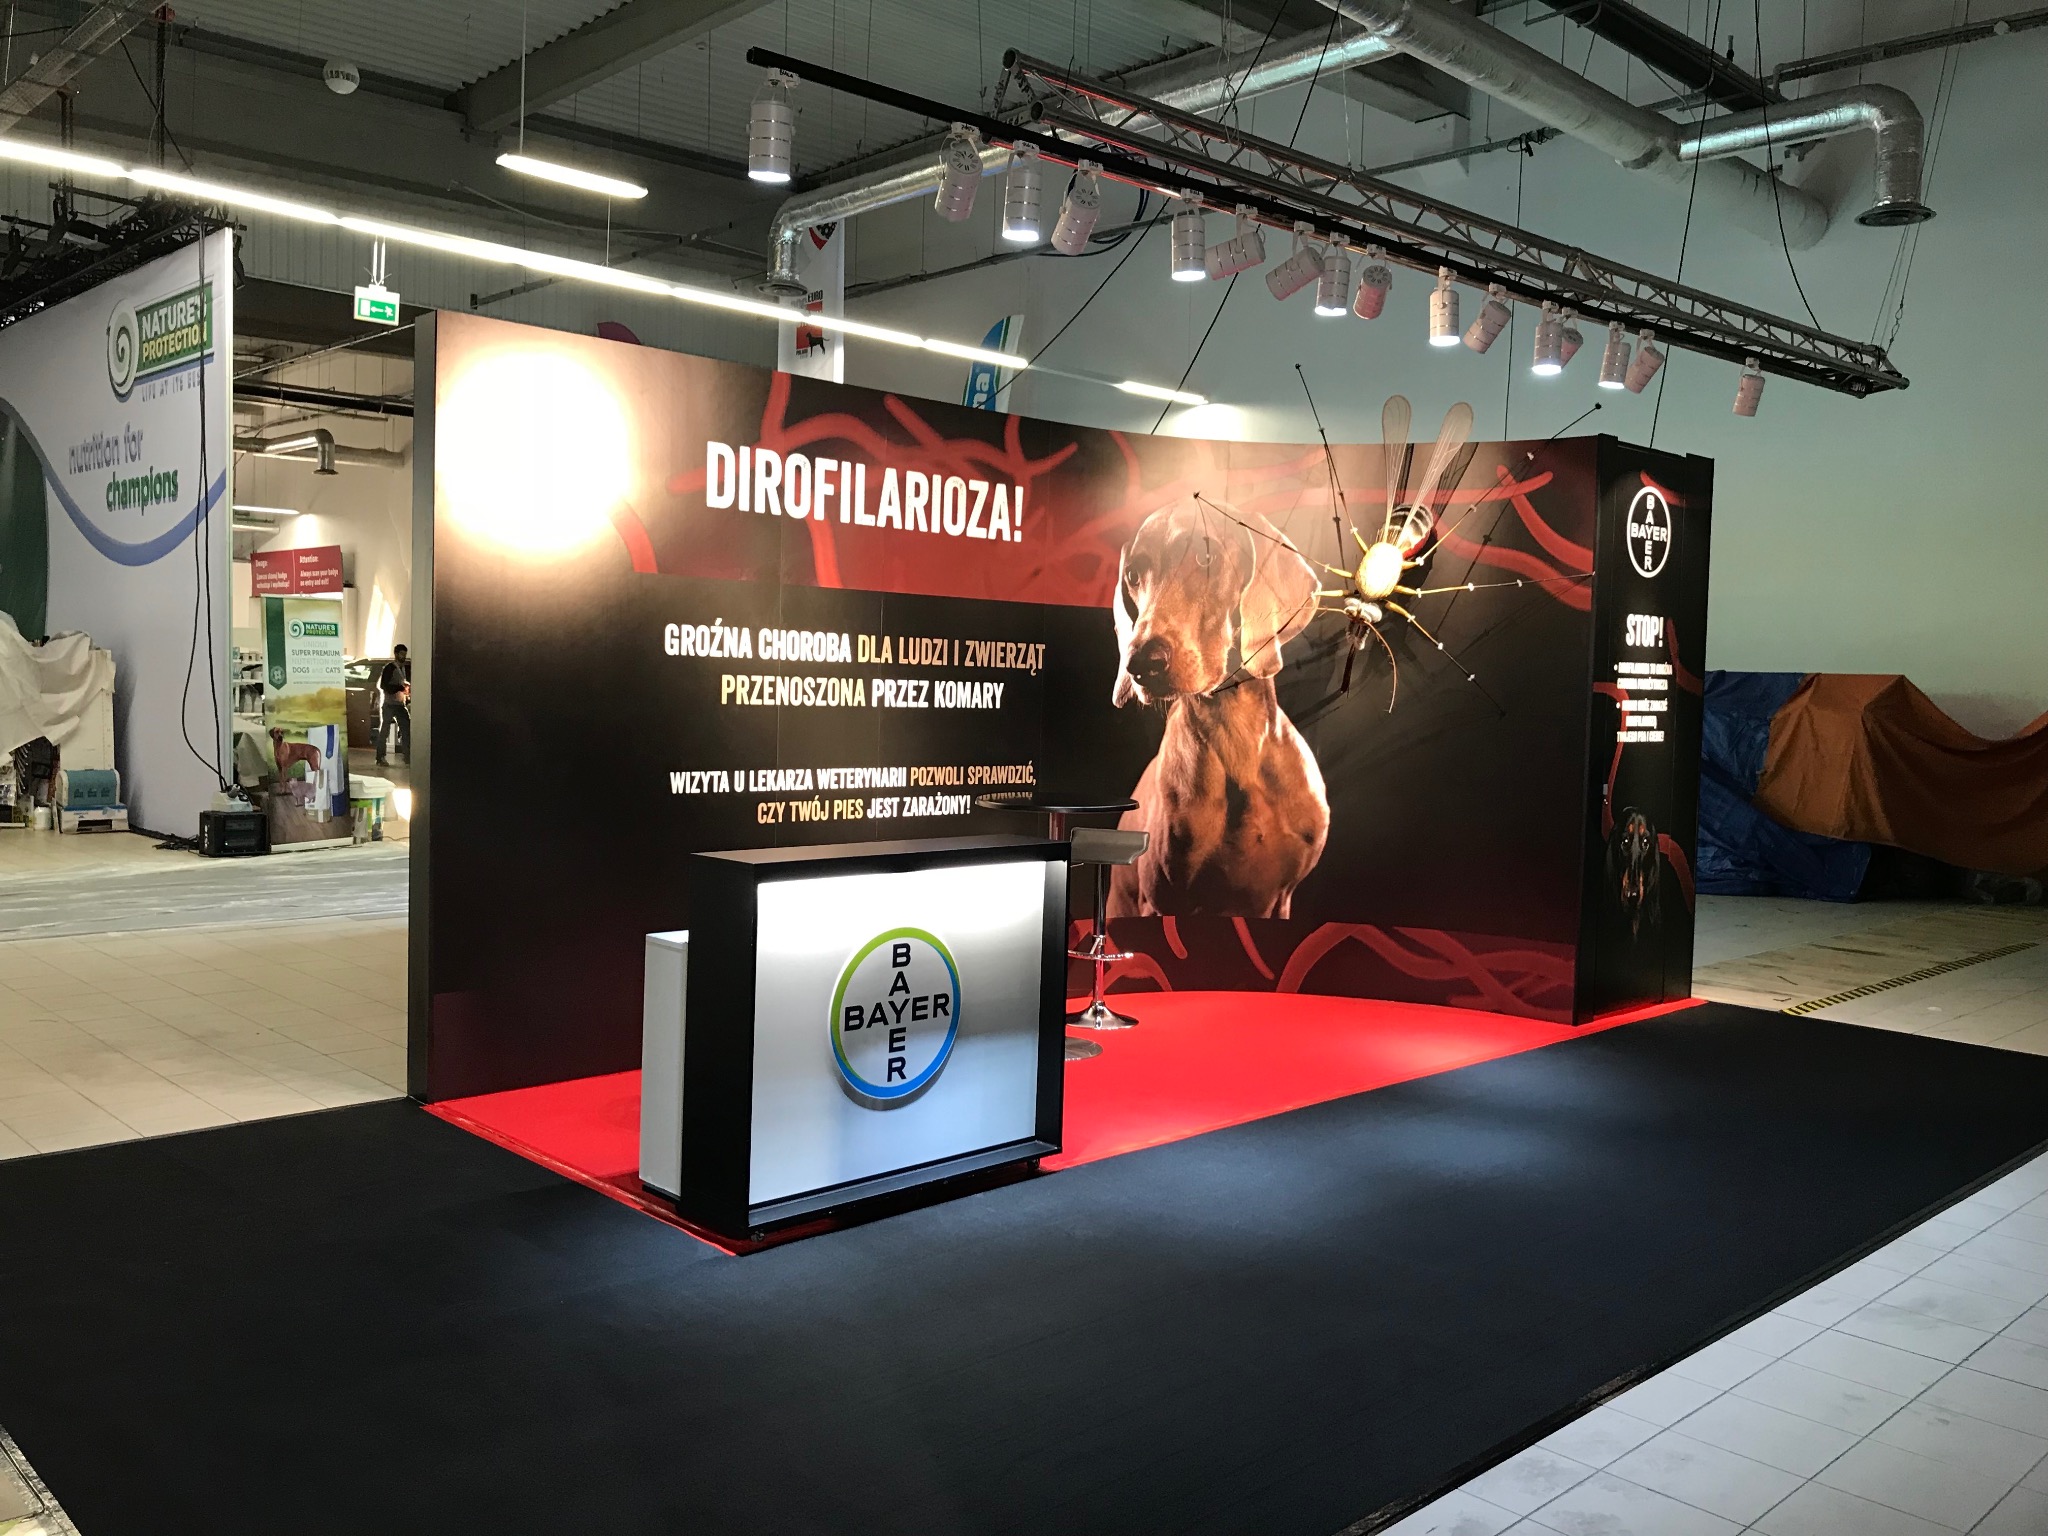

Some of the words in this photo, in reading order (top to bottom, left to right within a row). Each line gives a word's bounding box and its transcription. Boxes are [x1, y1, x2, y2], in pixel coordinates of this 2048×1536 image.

[69, 431, 120, 475] nutrition
[124, 421, 143, 463] for
[106, 465, 178, 516] champions
[706, 440, 1024, 543] DIROFILARIOZA!
[1631, 522, 1667, 542] BAYER
[1643, 494, 1655, 571] BAYER
[305, 623, 336, 631] NATURE'S
[1625, 613, 1664, 648] STOP!
[312, 649, 341, 657] PREMIUM
[664, 617, 753, 659] GROŹNA
[758, 628, 852, 663] CHOROBA
[857, 634, 893, 664] DLA
[898, 636, 948, 666] LUDZI
[954, 639, 959, 666] I
[964, 640, 1046, 676] ZWIERZĄT
[292, 666, 310, 674] DOGS
[721, 674, 866, 707] PRZENOSZONA
[871, 678, 930, 708] PRZEZ
[934, 680, 1005, 709] KOMARY
[669, 770, 730, 794] WIZYTA
[734, 770, 745, 793] U
[749, 768, 814, 792] LEKARZA
[816, 767, 907, 790] WETERYNARII
[910, 765, 964, 786] POZWOLI
[967, 760, 1037, 786] SPRAWDZIĆ,
[757, 801, 785, 824] CZY
[789, 795, 829, 823] TWÓJ
[833, 798, 863, 820] PIES
[867, 797, 900, 820] JEST
[902, 791, 971, 818] ZARAŻONY!
[843, 993, 950, 1032] BAYER
[886, 942, 911, 1083] BAYER
